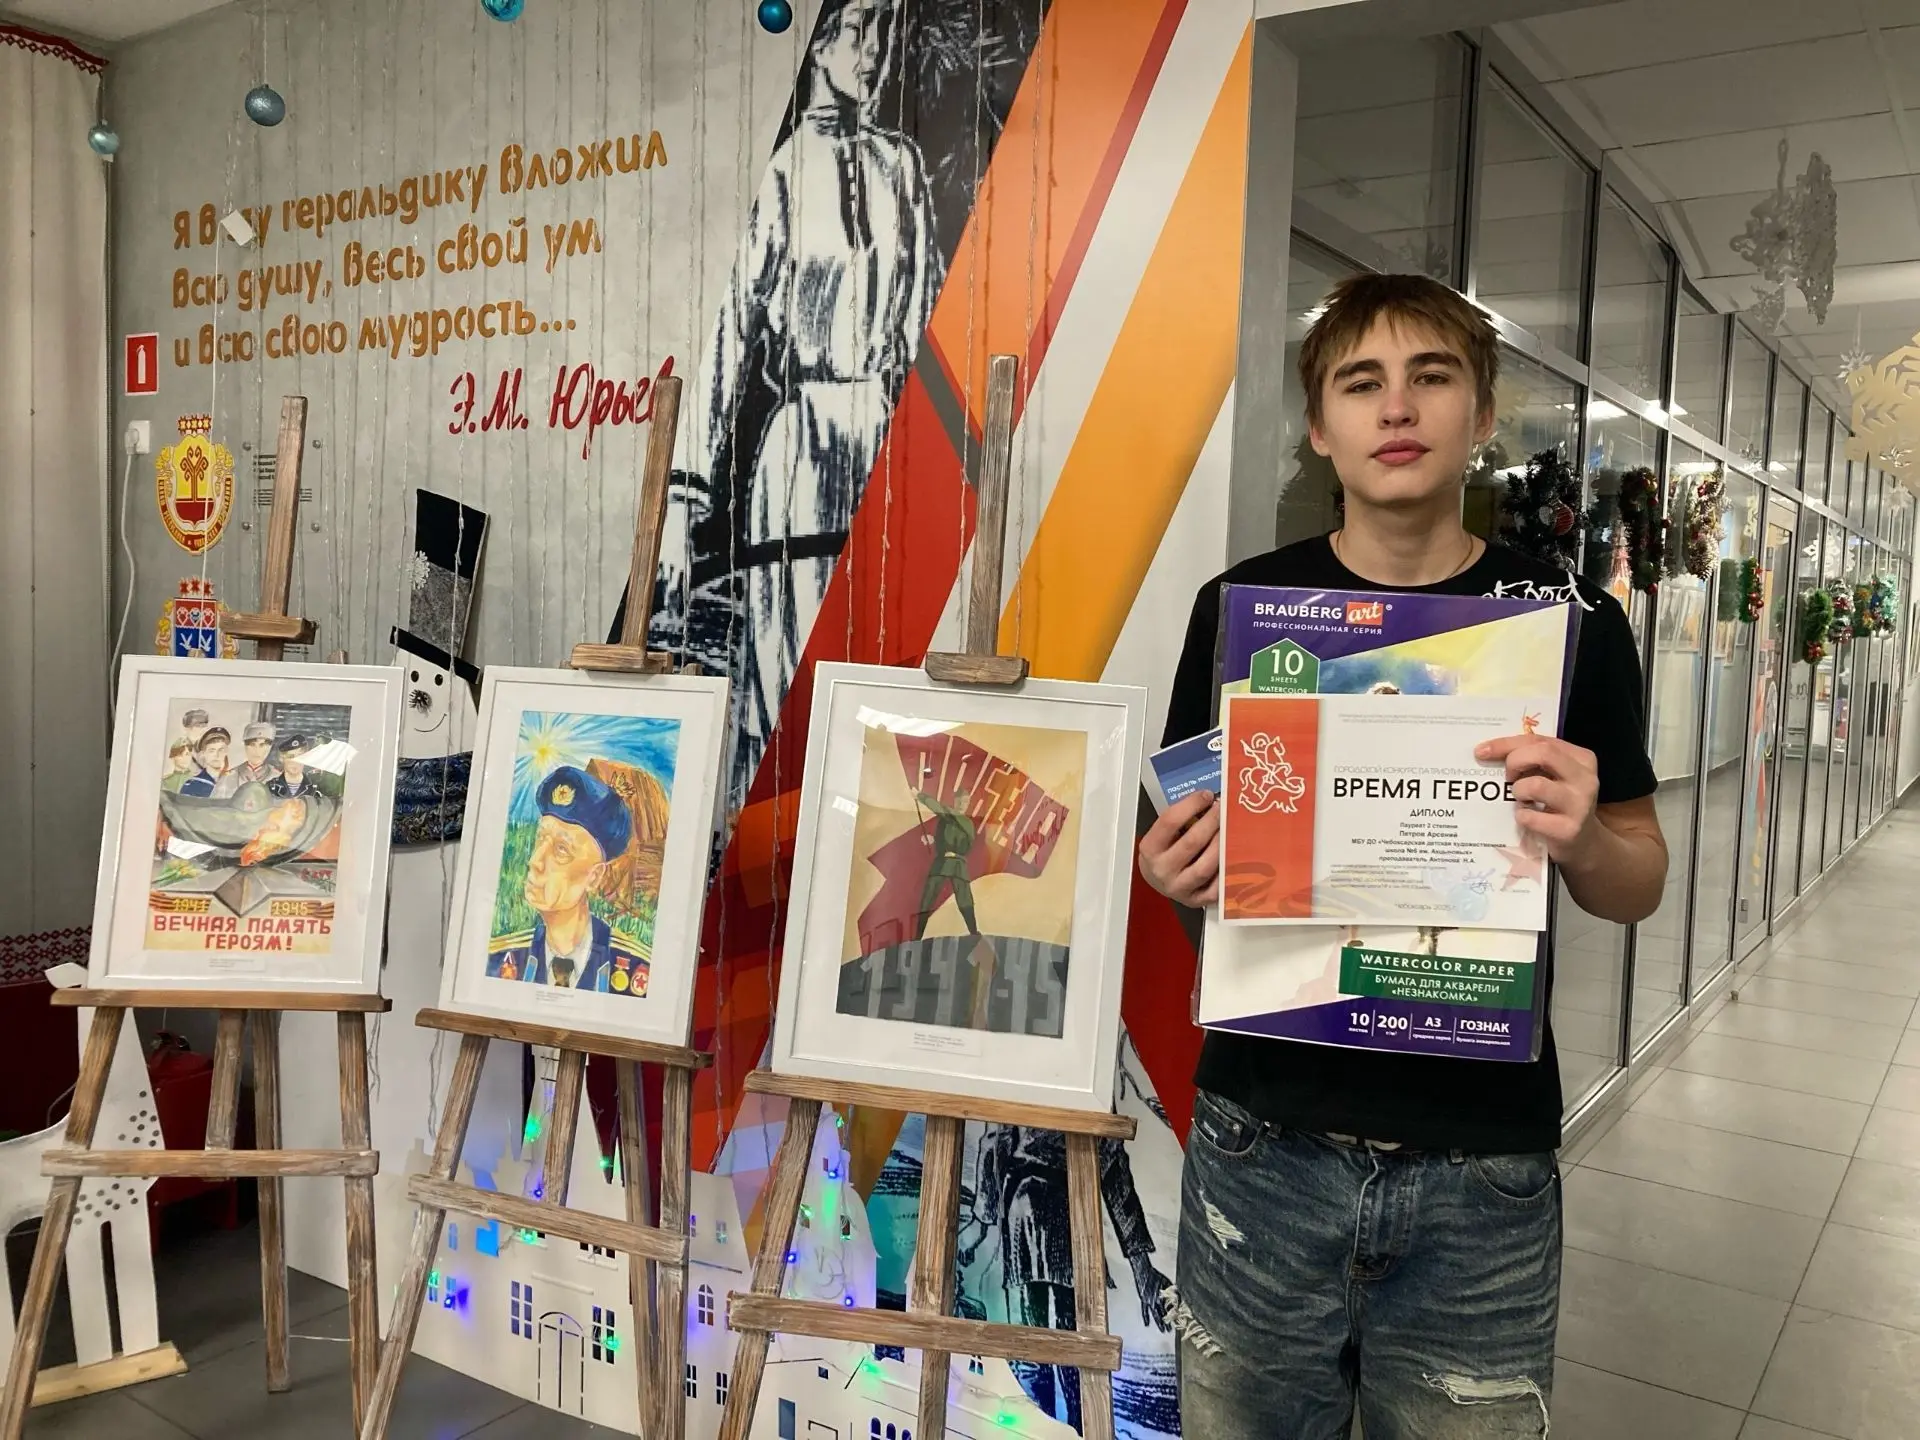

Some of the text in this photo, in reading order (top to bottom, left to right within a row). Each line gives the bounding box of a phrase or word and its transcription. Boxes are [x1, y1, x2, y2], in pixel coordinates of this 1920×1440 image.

[282, 164, 488, 239] геральдику
[500, 130, 668, 194] вложил
[173, 217, 602, 311] всю душу, весь свой ум
[174, 300, 577, 367] и всю свою мудрость...
[1254, 601, 1382, 622] BRAUBERG art
[1253, 621, 1382, 635] ПРОФЕССИОНАЛЬНАЯ СЕРИЯ
[1271, 649, 1304, 676] 10
[1258, 685, 1308, 694] WATERCOLOR
[1271, 676, 1298, 684] SHEETS
[1334, 778, 1420, 798] ВРЕМЯ
[1410, 809, 1455, 818] ДИПЛОМ
[272, 901, 309, 916] 1945
[154, 915, 331, 935] ВЕЧНАЯ ПАМЯТЬ
[205, 933, 293, 951] ГЕРОЯМ!
[1360, 953, 1515, 976] WATERCOLOR PAPER
[1375, 975, 1500, 994] БУМАГА ДЛЯ АКВАРЕЛИ
[1391, 987, 1479, 1002] «НЕЗНАКОМКА»
[1350, 1012, 1510, 1034] 10 200 А3 ГОЗНАК
